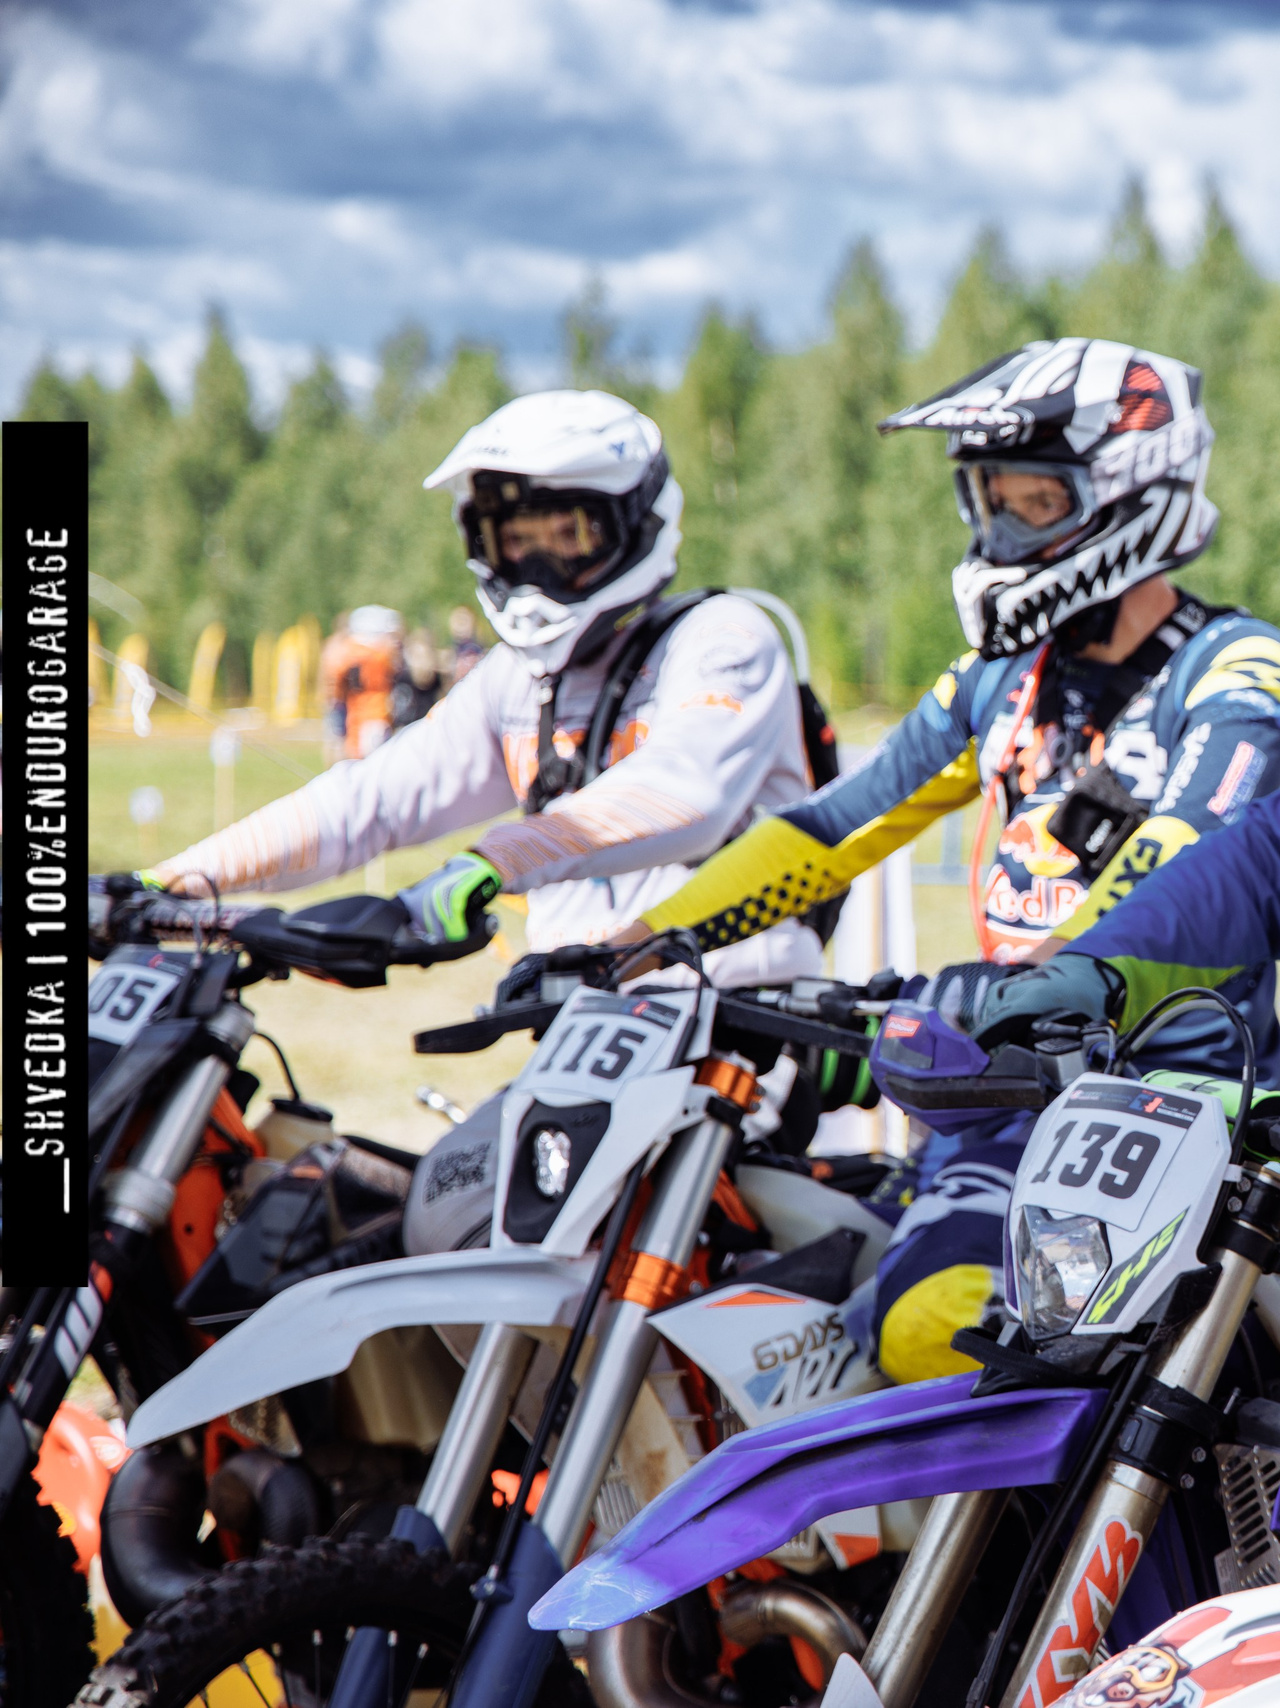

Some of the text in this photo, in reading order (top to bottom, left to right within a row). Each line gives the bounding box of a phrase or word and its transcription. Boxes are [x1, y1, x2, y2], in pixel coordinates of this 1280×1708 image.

[539, 1023, 647, 1081] 115
[1031, 1120, 1161, 1200] 139
[751, 1310, 845, 1373] 6DAYS
